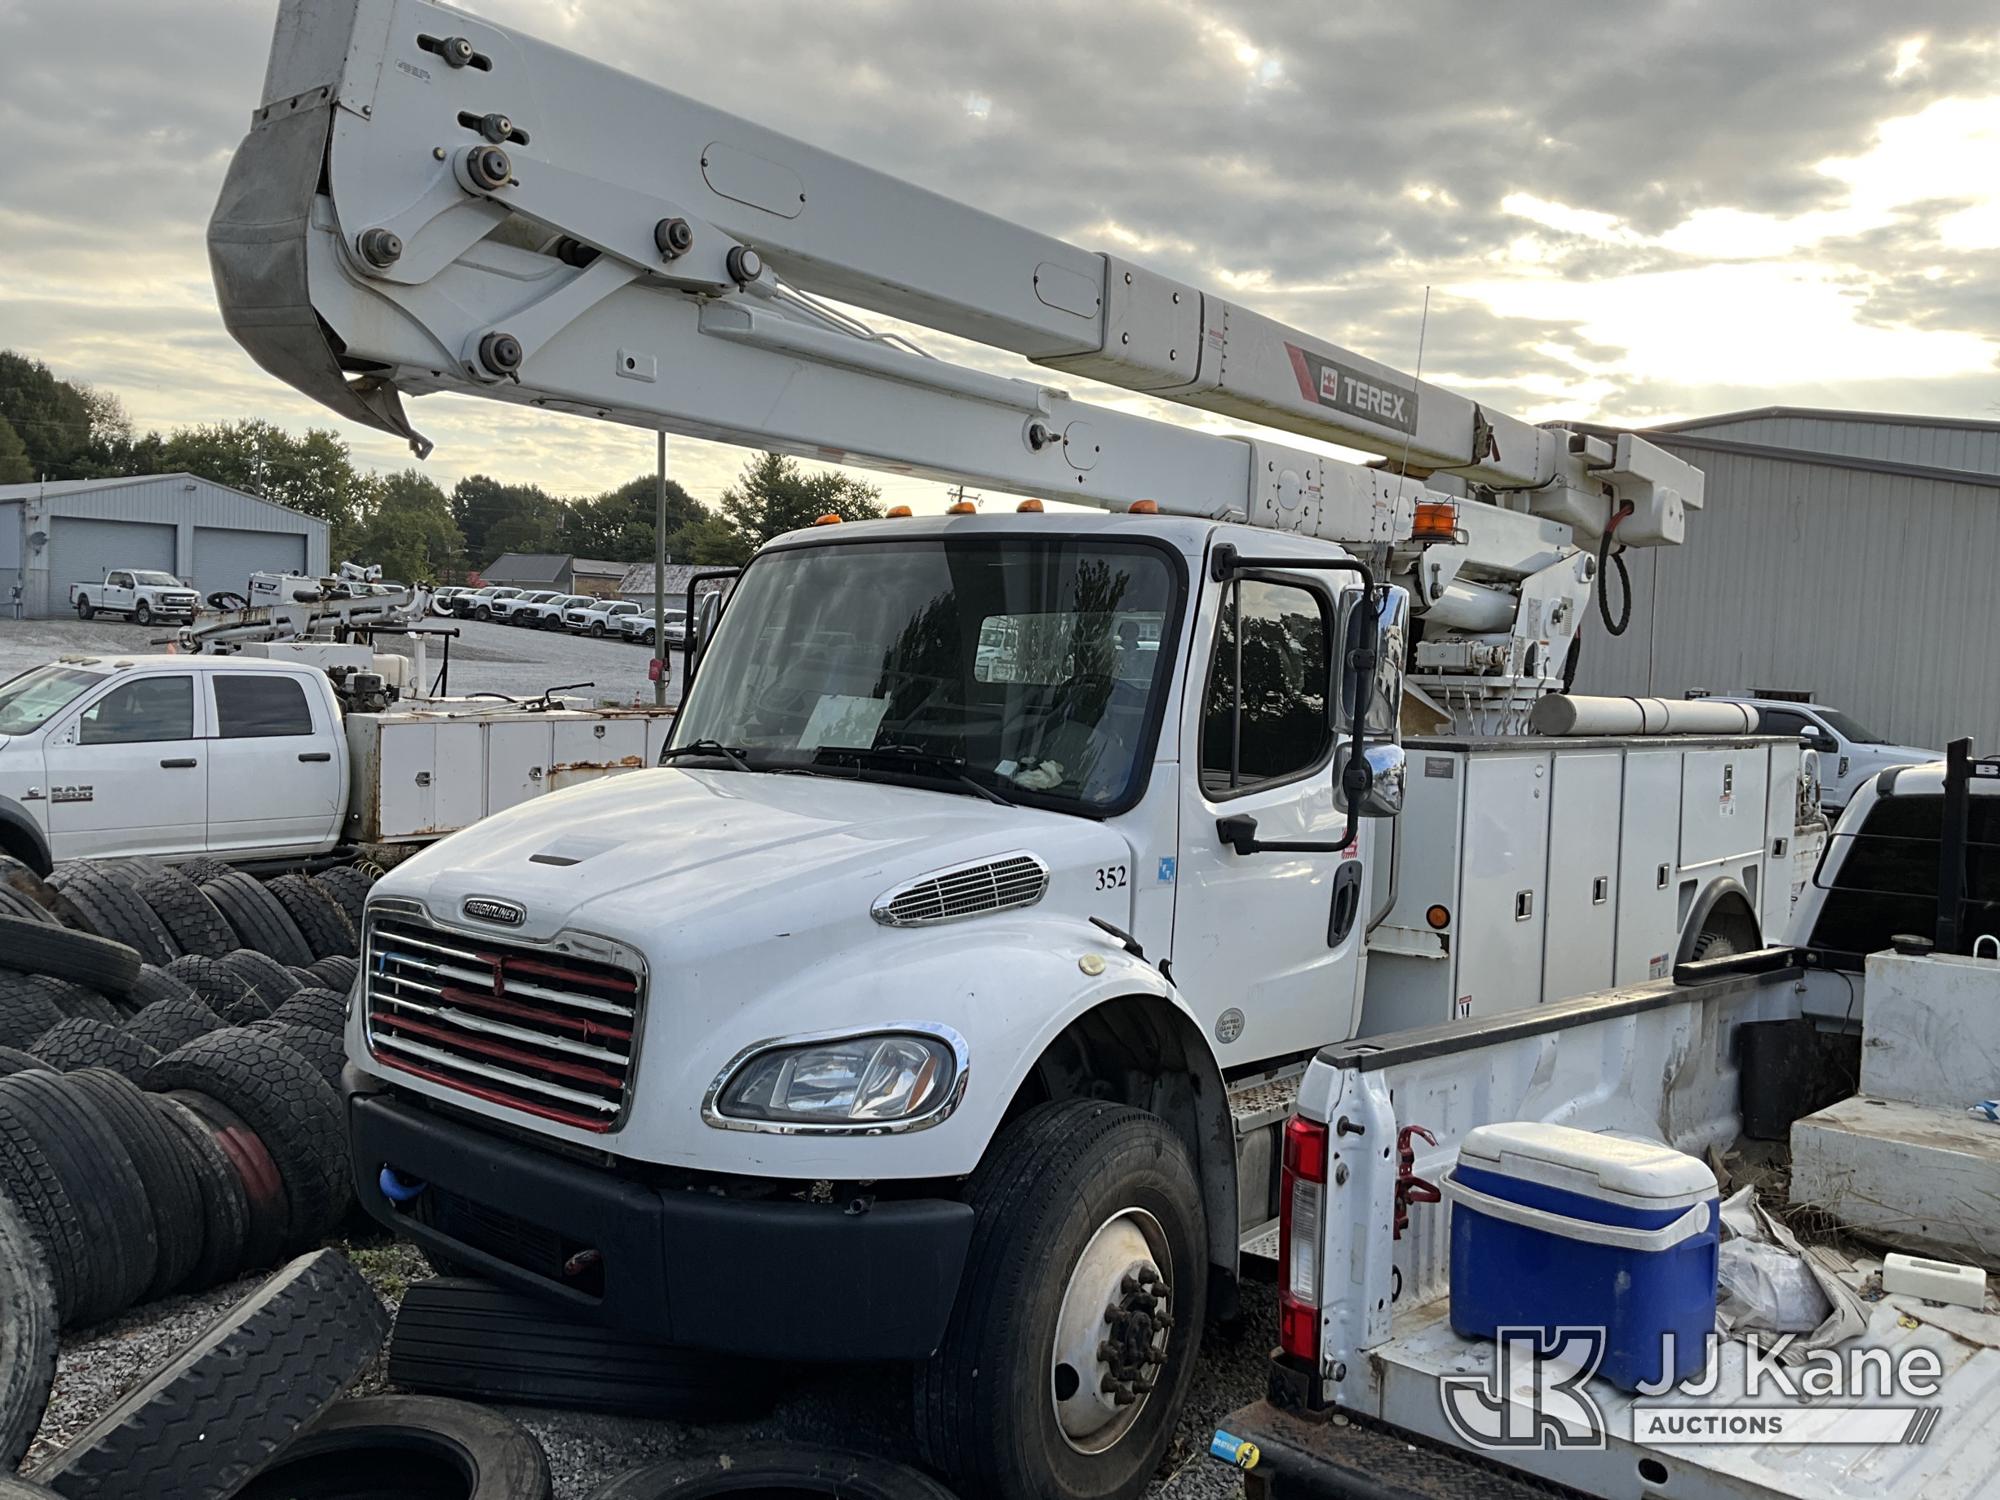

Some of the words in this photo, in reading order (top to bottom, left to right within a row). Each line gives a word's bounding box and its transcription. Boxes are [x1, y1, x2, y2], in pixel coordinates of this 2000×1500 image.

[1343, 376, 1404, 422] TEREX
[1095, 865, 1127, 891] 352
[466, 901, 517, 921] FREIGHTLINER
